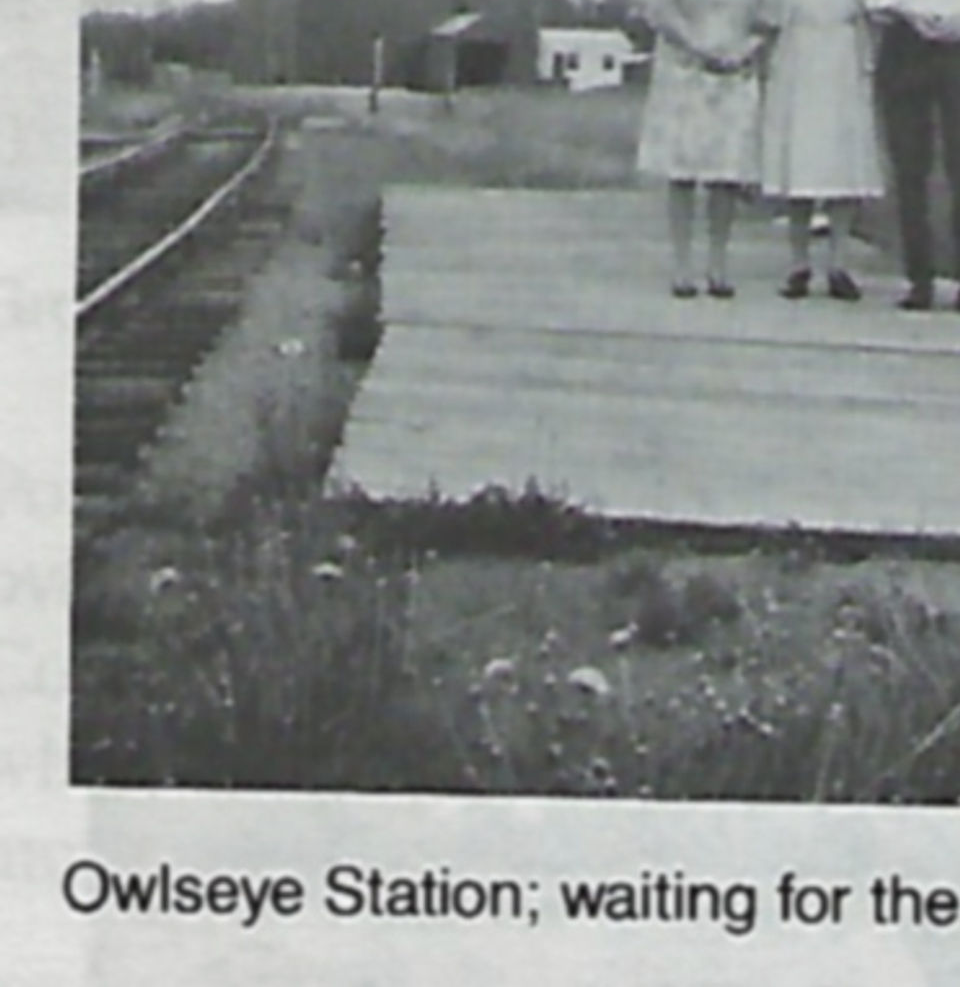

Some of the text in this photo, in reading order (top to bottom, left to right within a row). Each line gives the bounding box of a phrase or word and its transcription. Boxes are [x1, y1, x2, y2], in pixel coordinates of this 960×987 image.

[62, 860, 303, 925] Owlseye
[325, 865, 538, 922] Station;
[561, 872, 756, 934] waiting
[777, 872, 850, 922] for
[871, 875, 958, 925] the
